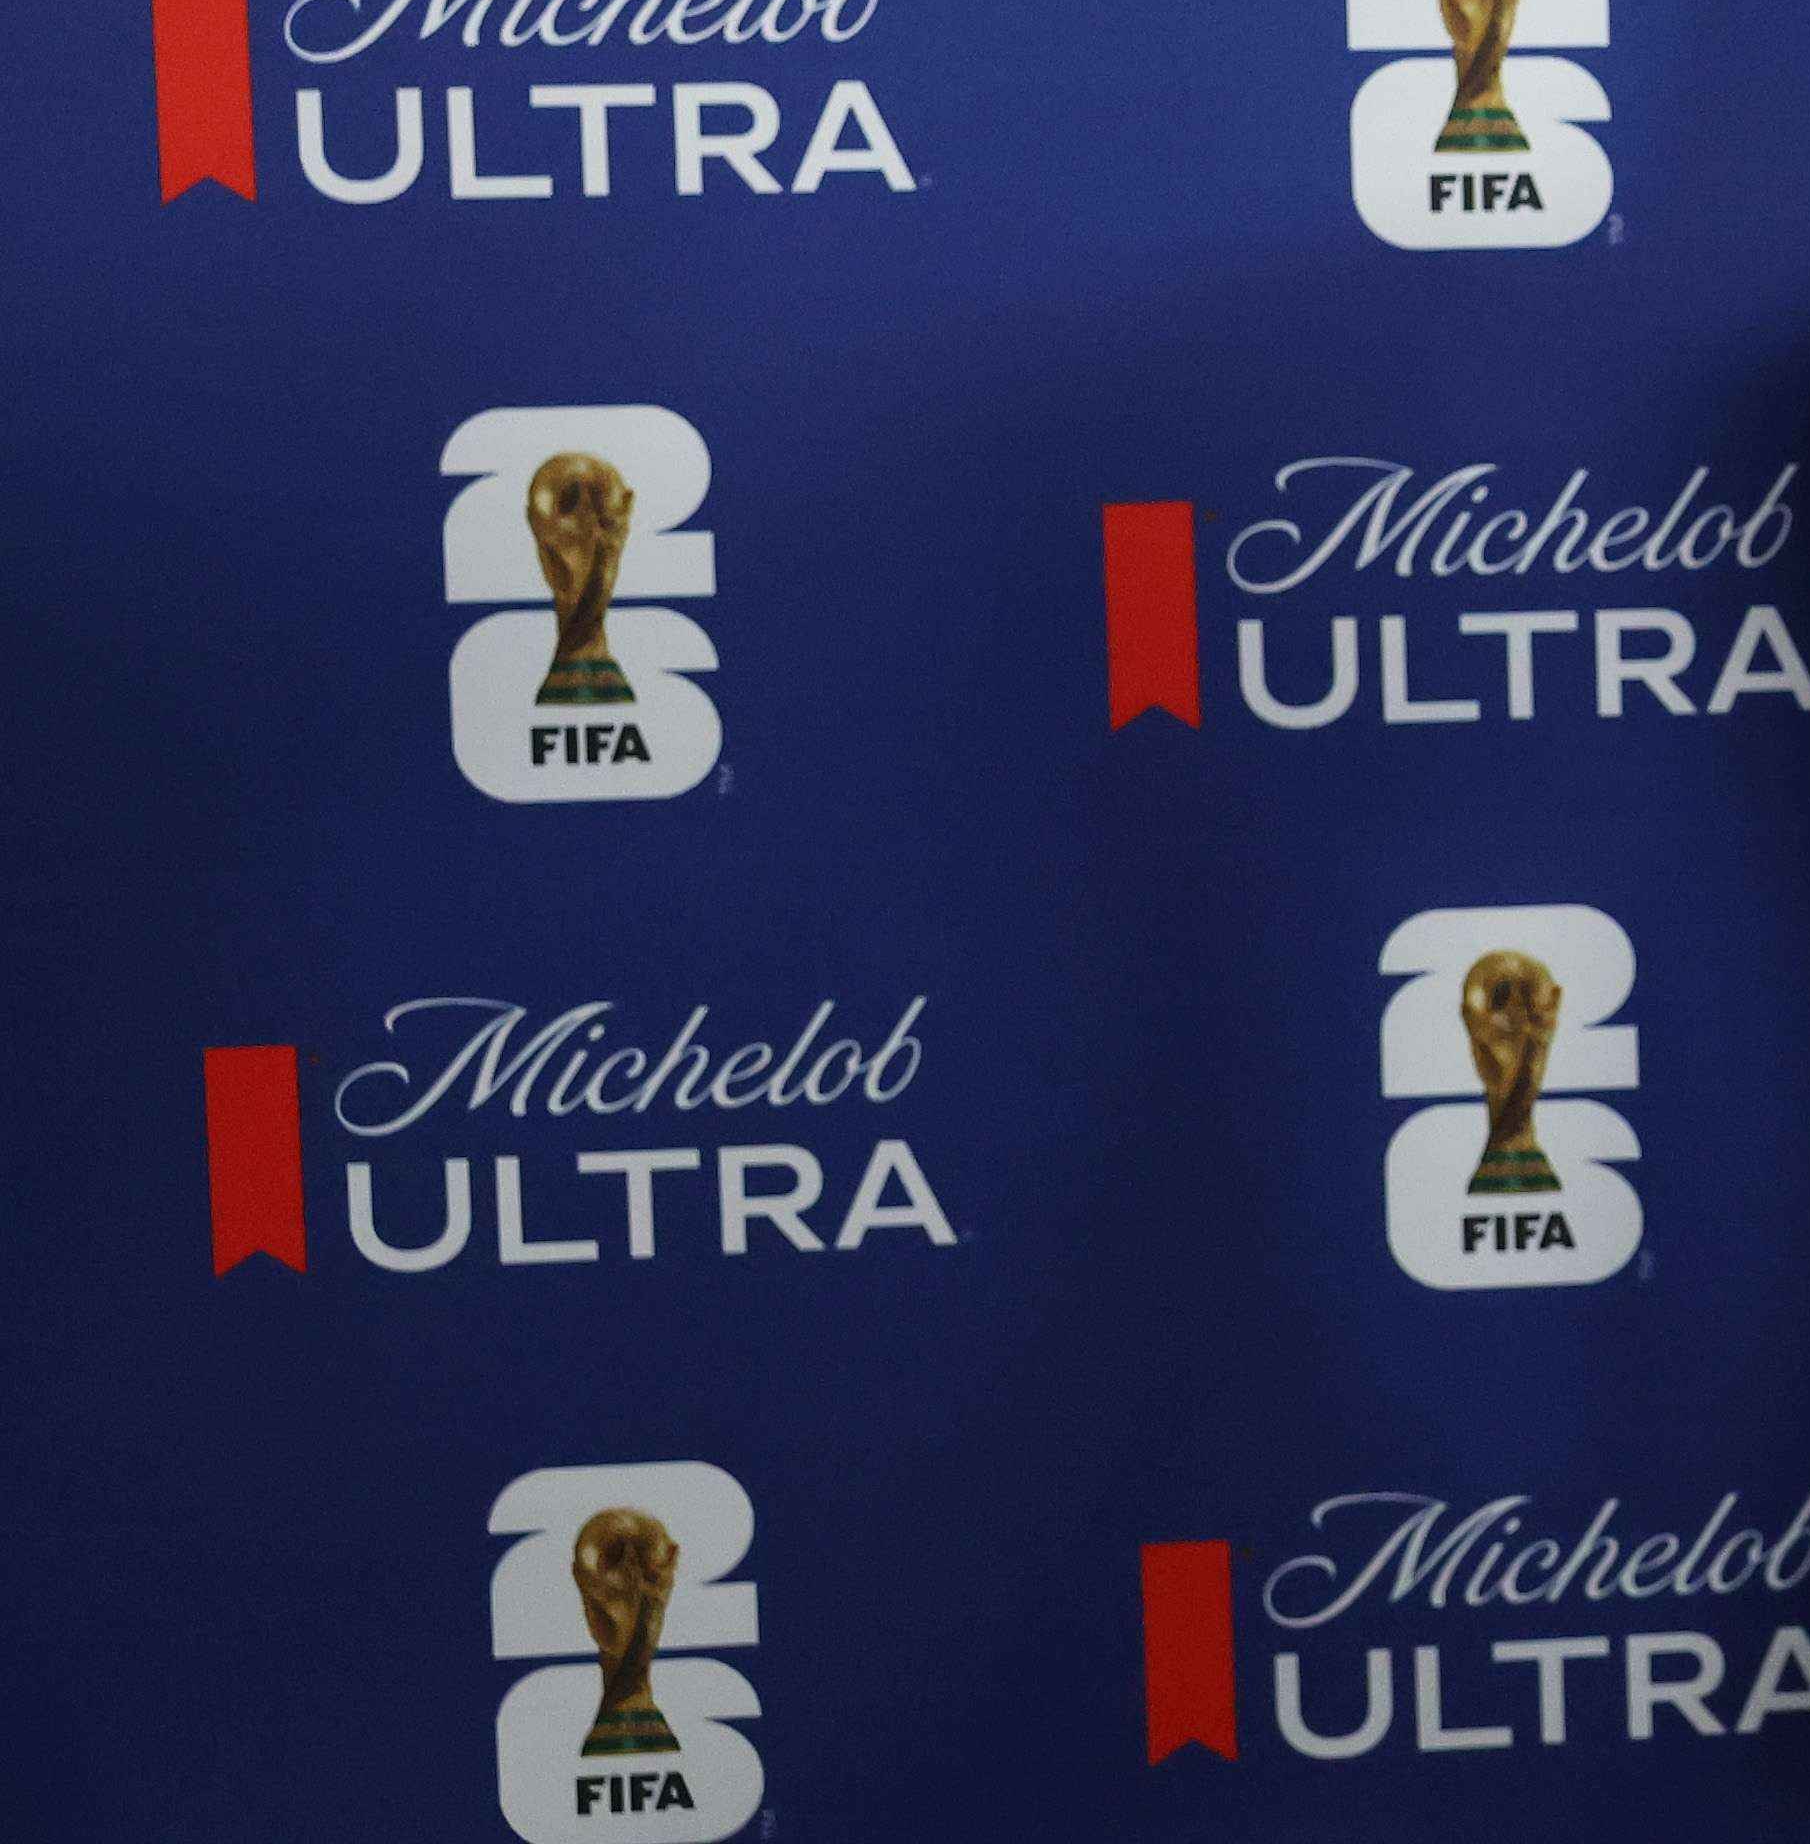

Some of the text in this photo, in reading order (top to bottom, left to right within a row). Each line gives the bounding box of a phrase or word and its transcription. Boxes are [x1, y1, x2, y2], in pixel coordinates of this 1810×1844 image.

[296, 80, 916, 204] ULTRA
[1430, 173, 1543, 213] FIFA
[1227, 457, 1795, 594] Michelob
[530, 723, 651, 766] FIFA
[335, 996, 926, 1136] Michelob
[347, 1140, 957, 1272] ULTRA
[1462, 1212, 1576, 1254] FIFA
[576, 1771, 695, 1816] FIFA
